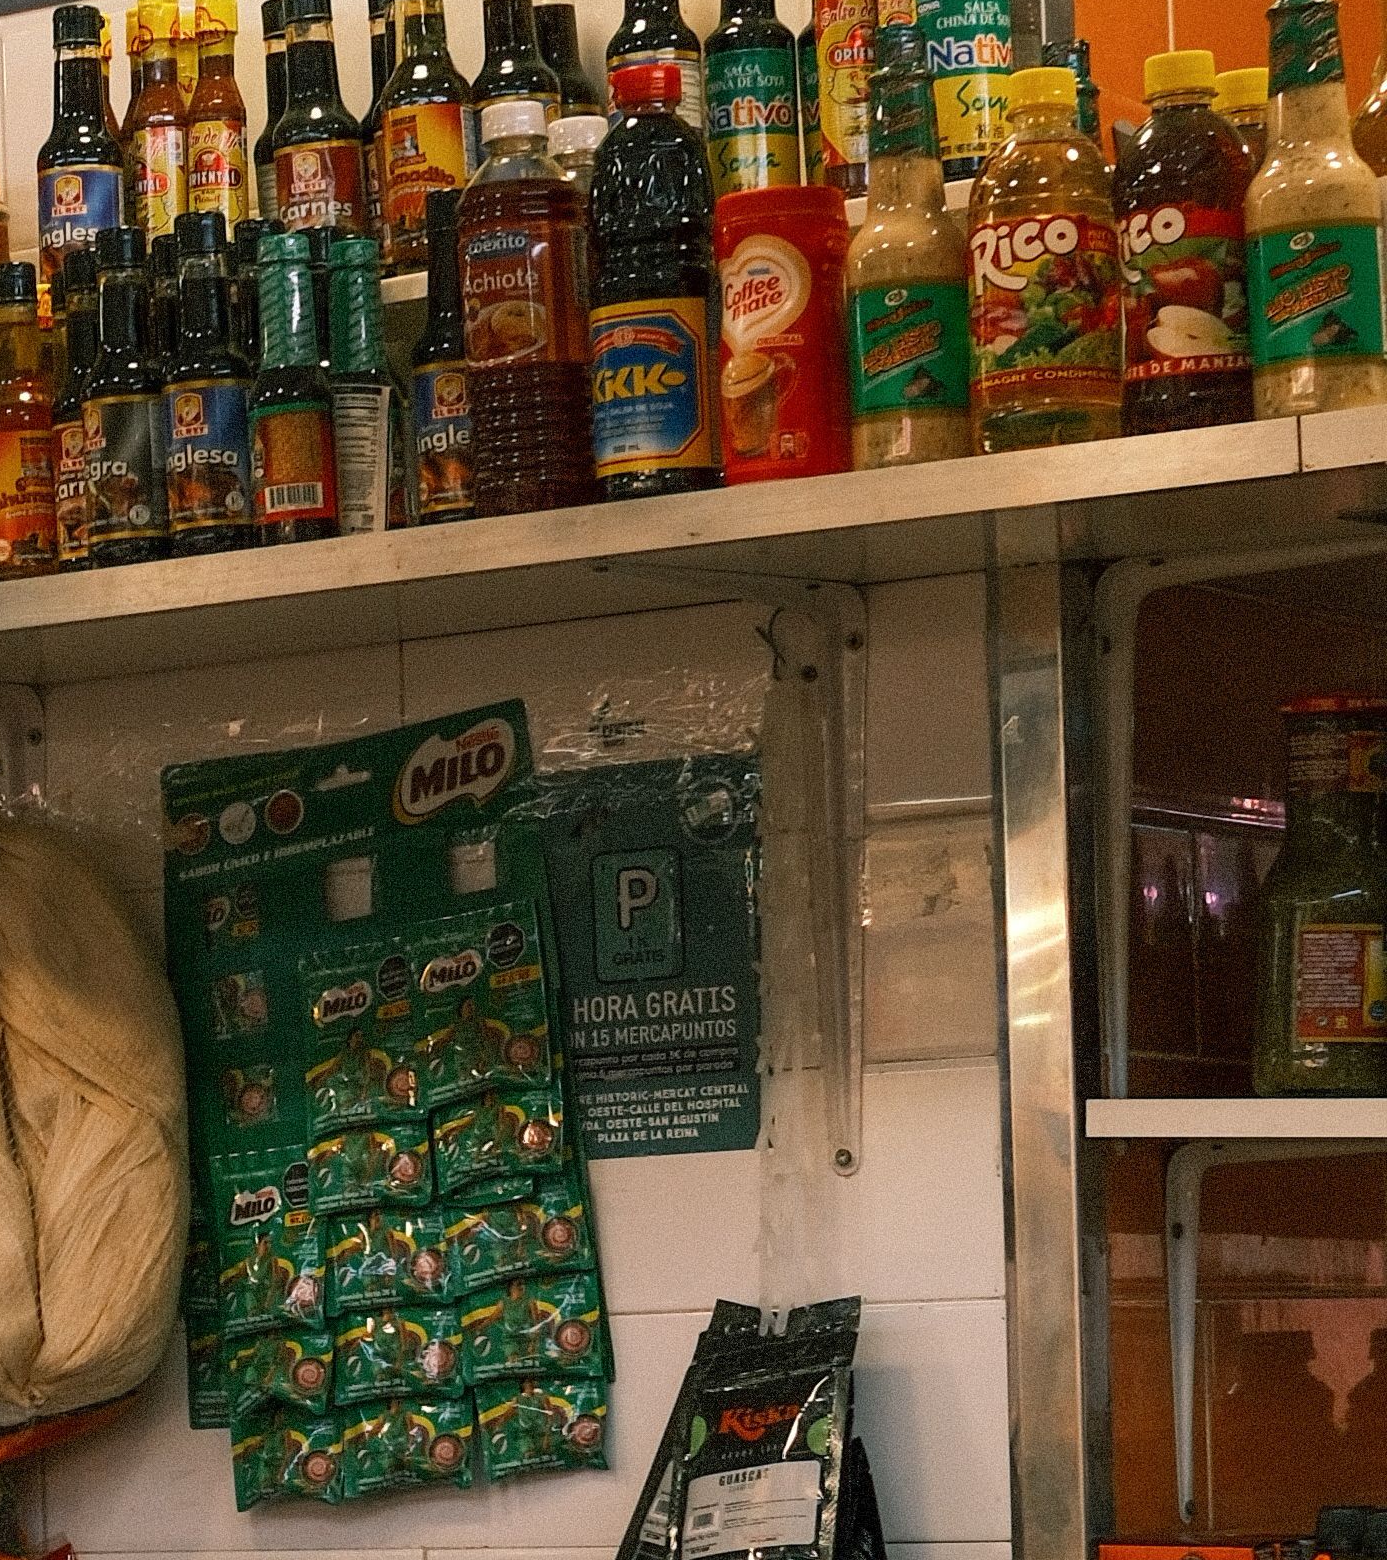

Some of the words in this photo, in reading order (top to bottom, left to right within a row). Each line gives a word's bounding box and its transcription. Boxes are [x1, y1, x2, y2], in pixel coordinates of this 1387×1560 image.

[964, 1, 1000, 15] SALSA
[723, 275, 783, 309] Coffee
[732, 290, 784, 318] mate
[410, 741, 506, 804] MILO
[618, 866, 659, 929] P
[429, 960, 478, 988] MILO
[574, 995, 639, 1024] HORA
[646, 986, 737, 1018] GRATIS
[591, 1028, 609, 1048] 15
[615, 1019, 737, 1045] MERCAPUNTOS
[700, 1082, 750, 1096] CENTRAL
[687, 1097, 741, 1110] HOSPITAL
[598, 1132, 630, 1144] PLAZA
[633, 1130, 647, 1142] DE
[650, 1129, 663, 1141] LA
[666, 1128, 700, 1140] REINA
[233, 1193, 278, 1222] MILO
